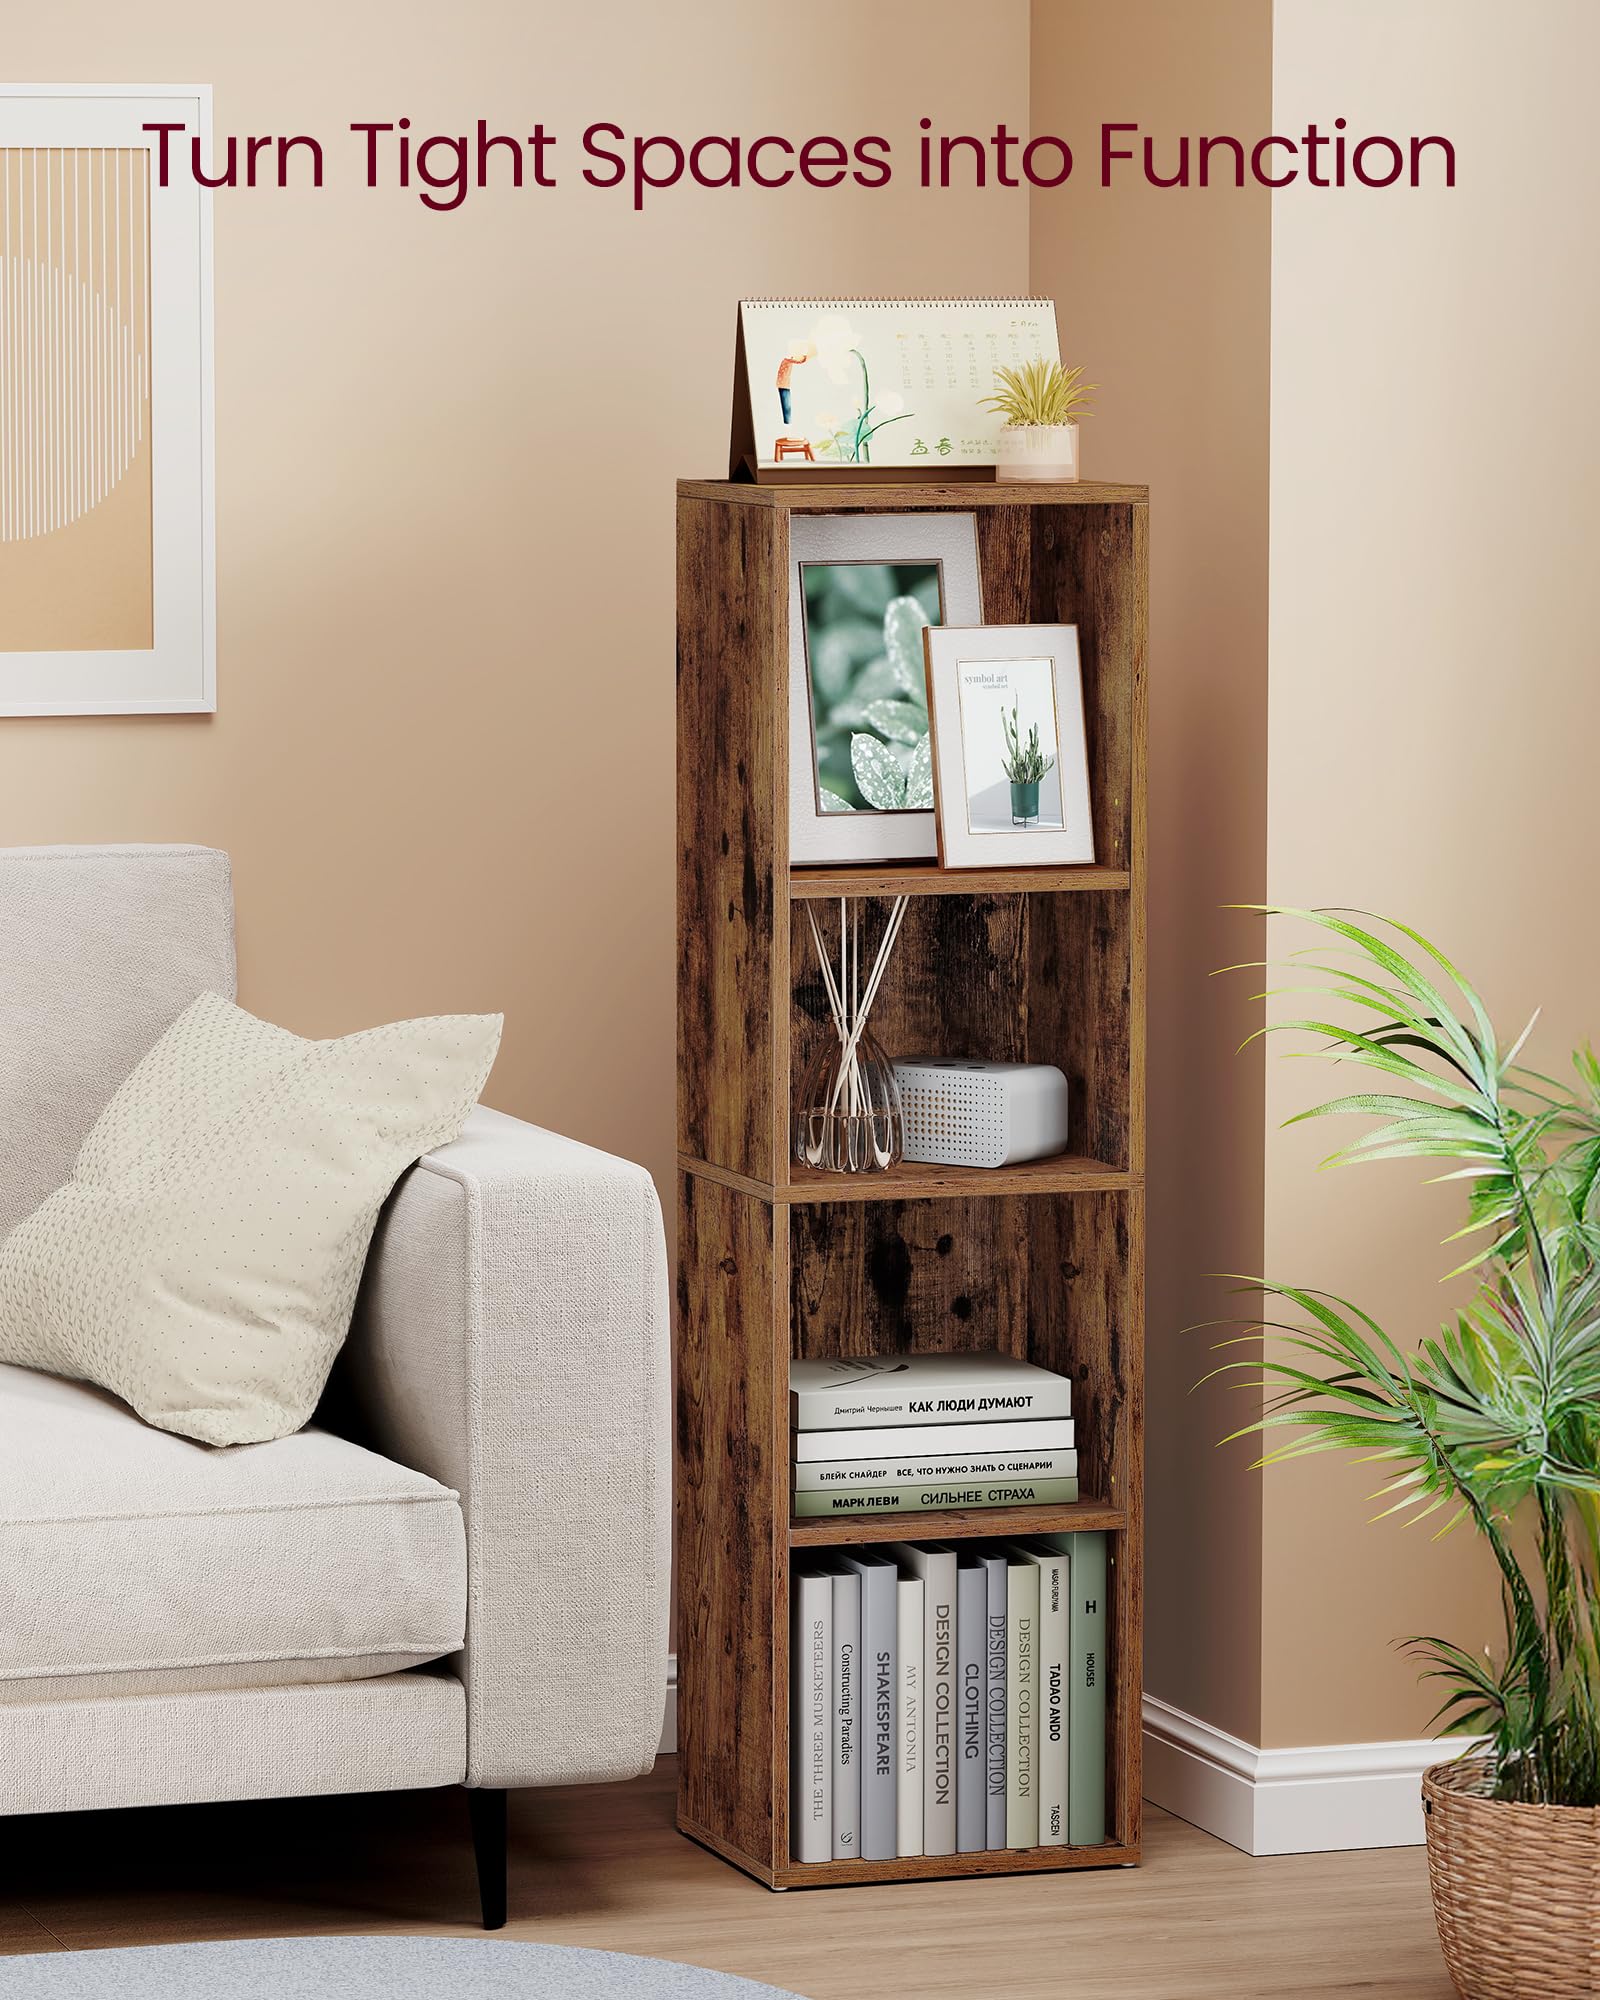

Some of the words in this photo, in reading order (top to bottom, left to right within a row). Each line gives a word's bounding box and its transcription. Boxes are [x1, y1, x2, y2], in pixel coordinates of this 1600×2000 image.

[964, 673, 994, 685] symbol
[996, 674, 1008, 683] art
[834, 1405, 865, 1415] Дмитрий
[867, 1404, 903, 1414] Чернышев
[909, 1400, 934, 1414] КАК
[936, 1398, 976, 1413] ЛЮДИ
[978, 1395, 1034, 1412] ДУМАЮТ
[820, 1471, 847, 1481] БЛЕЙК
[849, 1469, 888, 1479] СНАЙДЕР
[896, 1468, 915, 1477] ВСЕ,
[917, 1467, 934, 1475] ЧТО
[935, 1465, 968, 1474] НУЖНО
[970, 1464, 997, 1473] ЗНАТЬ
[998, 1463, 1006, 1471] О
[1007, 1461, 1053, 1471] СЦЕНАРИИ
[832, 1499, 864, 1509] МАРК
[866, 1495, 900, 1507] ЛЕВИ
[920, 1490, 983, 1505] СИЛЬНЕЕ
[987, 1488, 1036, 1501] СТРАХА
[1085, 1600, 1097, 1614] H
[935, 1604, 950, 1677] DESIGN
[989, 1615, 1006, 1681] DESIGN
[1018, 1617, 1031, 1684] DESIGN
[813, 1619, 824, 1727] MUSKETEERS
[838, 1643, 854, 1716] Constructing
[905, 1664, 916, 1690] MY
[1049, 1663, 1061, 1705] TADAO
[1085, 1652, 1096, 1688] HOUSES
[876, 1651, 890, 1776] SHAKESPEARE
[905, 1696, 917, 1774] ANTONIA
[964, 1663, 980, 1760] CLOTHING
[1049, 1707, 1061, 1742] ANDO
[813, 1731, 824, 1785] THREE
[841, 1718, 853, 1766] Paradies
[935, 1681, 950, 1806] COLLECTION
[988, 1687, 1006, 1797] COLLECTION
[1018, 1689, 1031, 1799] COLLECTION
[813, 1788, 824, 1821] THE
[1050, 1804, 1060, 1836] TASCEN
